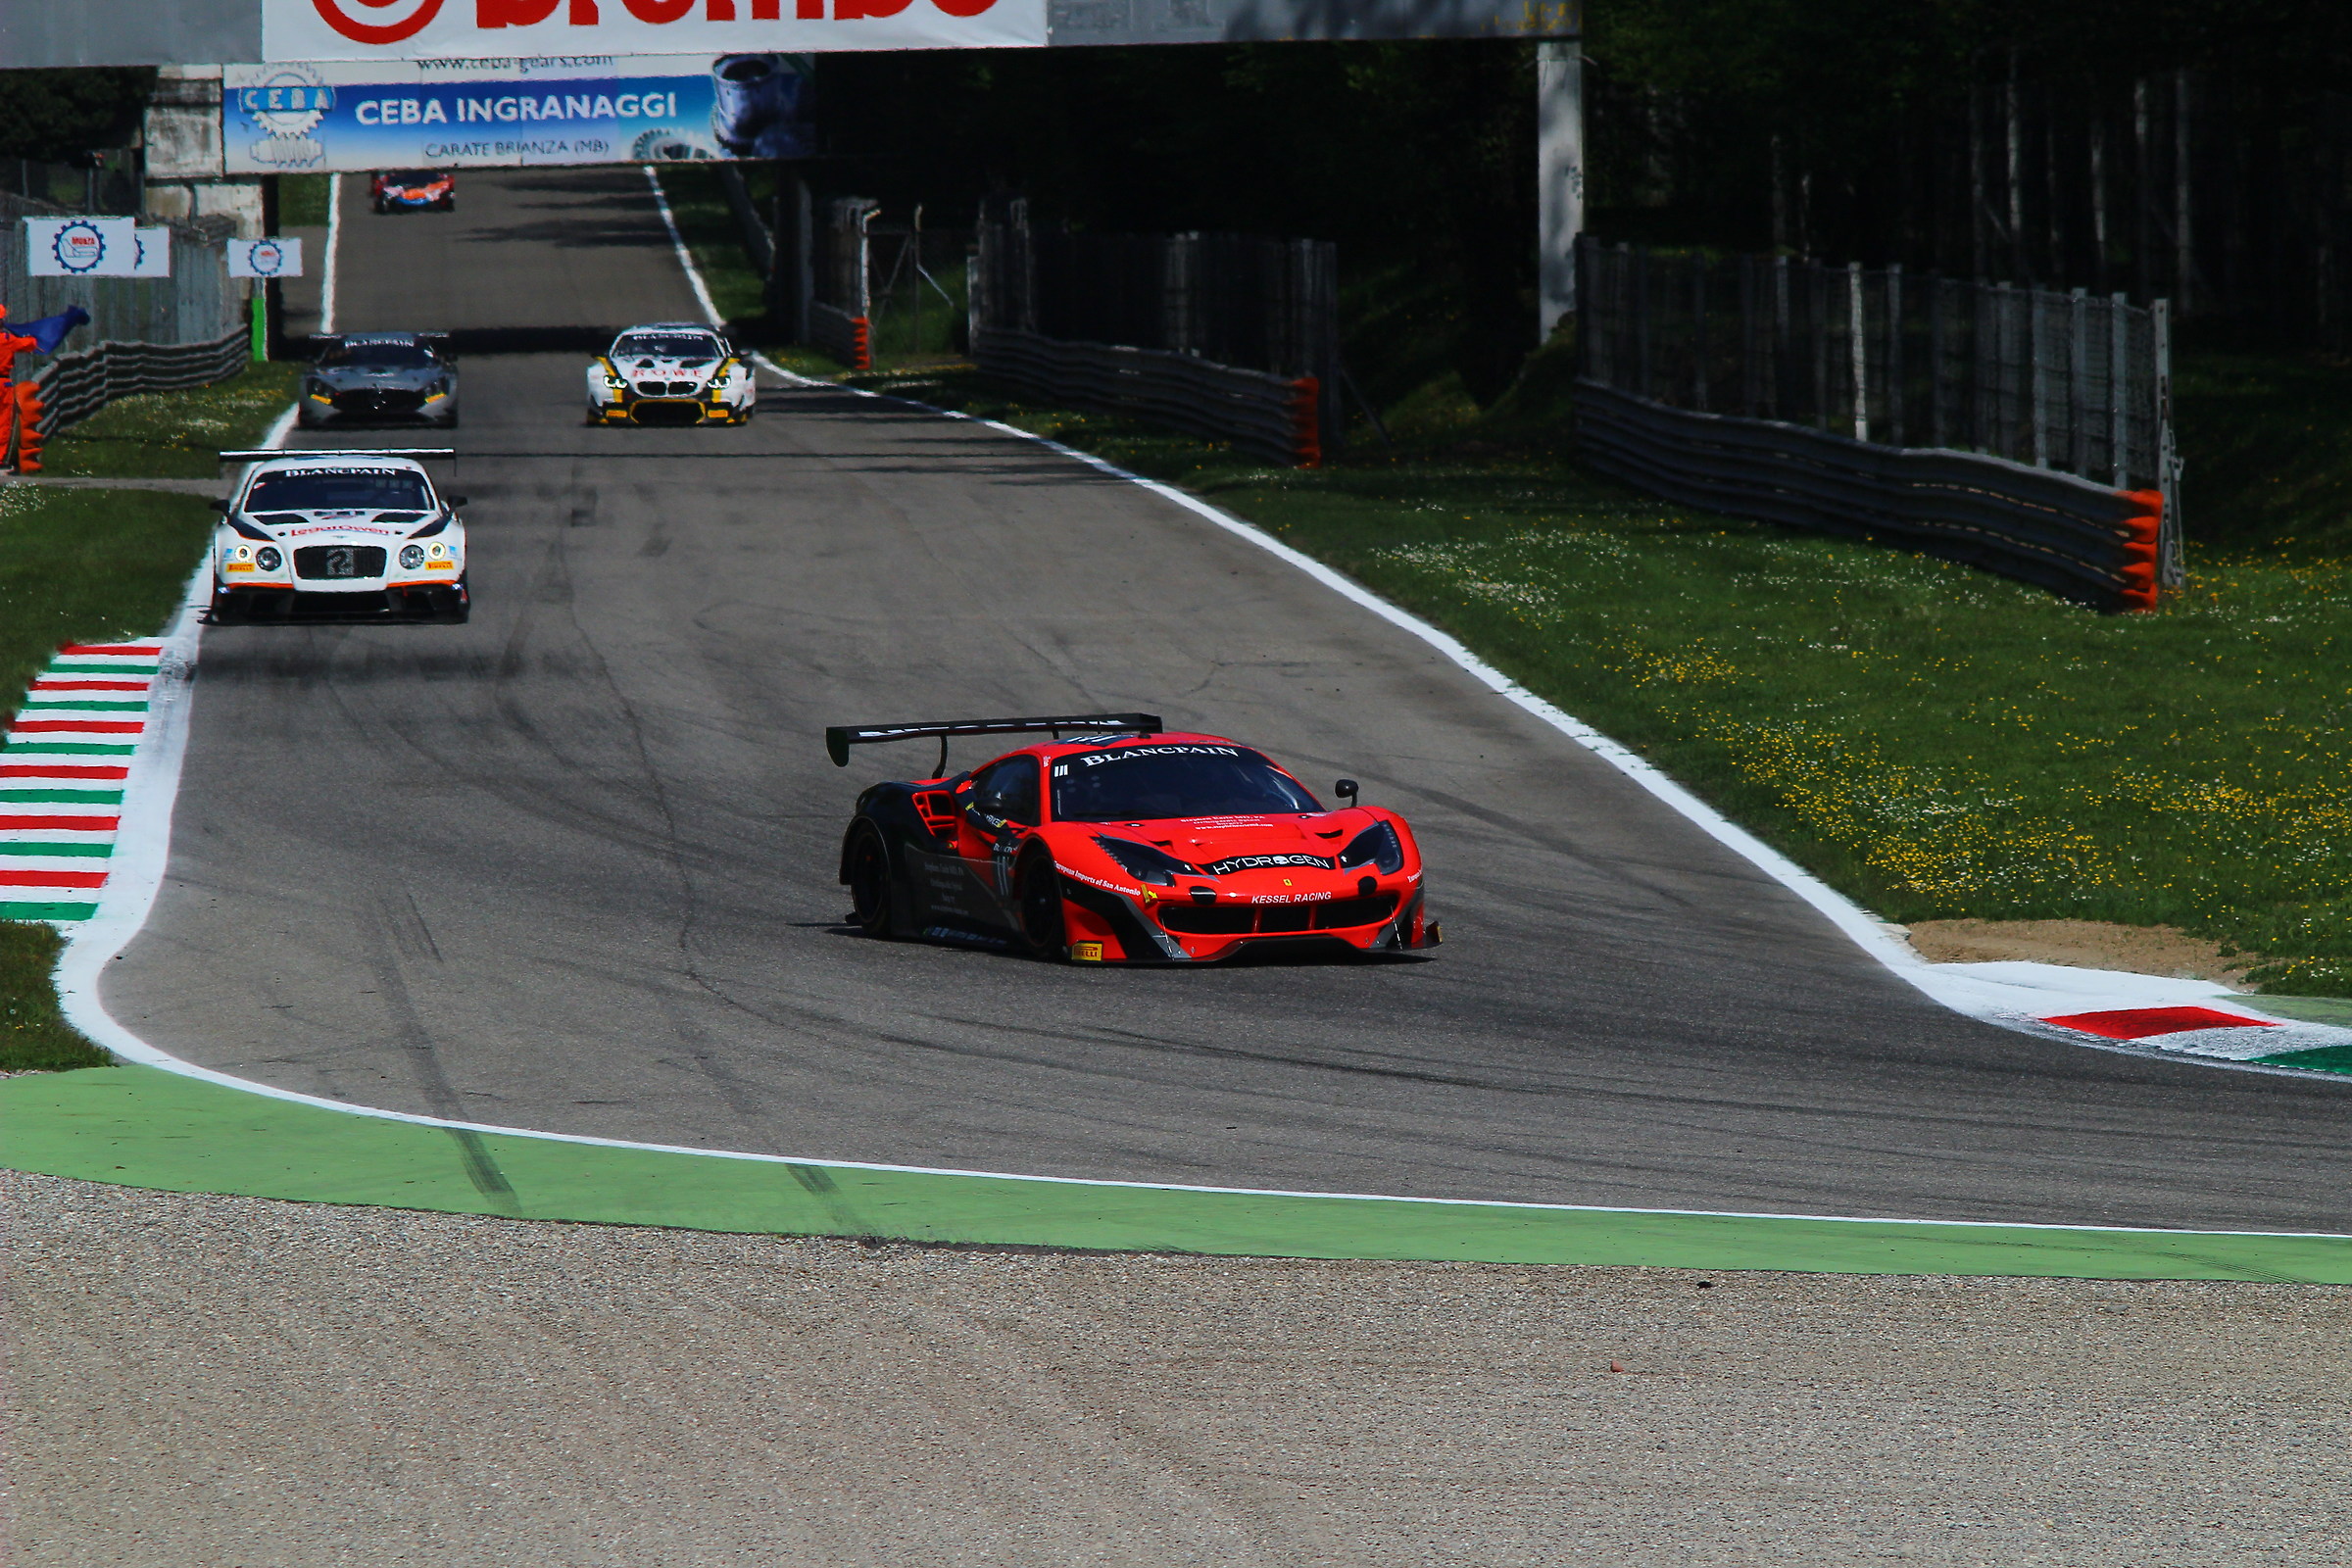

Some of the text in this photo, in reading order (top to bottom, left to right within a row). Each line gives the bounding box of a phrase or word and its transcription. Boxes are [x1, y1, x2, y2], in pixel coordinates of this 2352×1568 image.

[244, 88, 329, 110] CEBA
[355, 92, 677, 125] CEBA INGRANAGGI
[425, 139, 610, 158] CARATE BRIANZA (MB)
[285, 467, 397, 478] BLANCPAIN
[1080, 746, 1240, 767] BLANCPAIN
[1212, 855, 1331, 875] HYDROGEN
[1075, 869, 1096, 884] Imports
[1101, 880, 1114, 890] San
[1113, 884, 1141, 897] Antonio
[1250, 892, 1332, 905] KESSEL RACING
